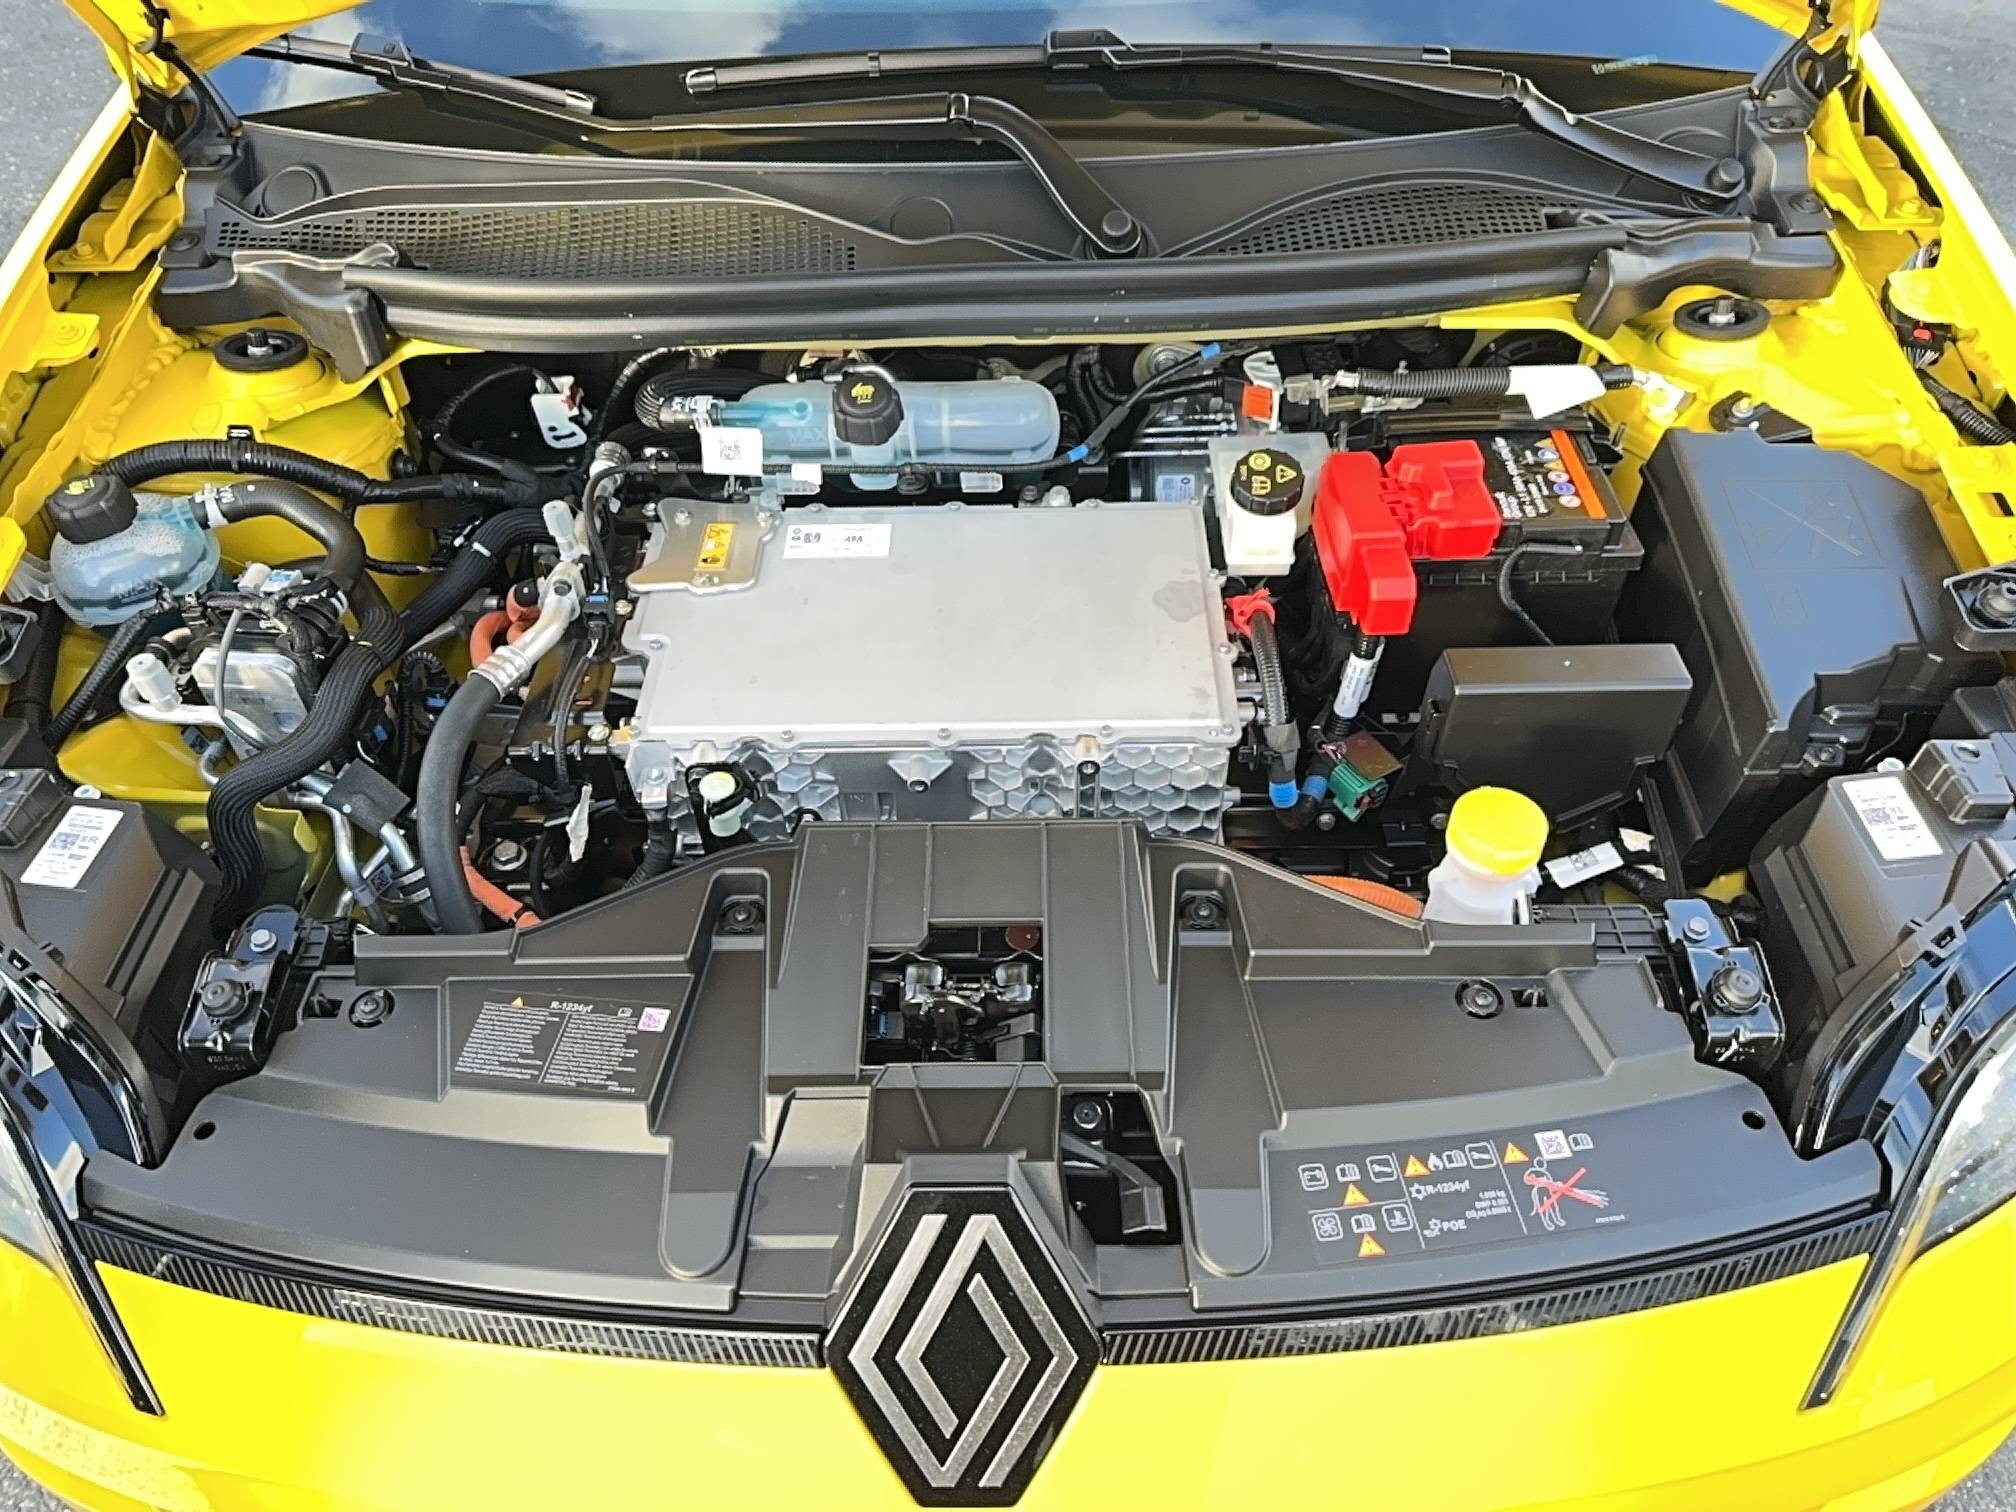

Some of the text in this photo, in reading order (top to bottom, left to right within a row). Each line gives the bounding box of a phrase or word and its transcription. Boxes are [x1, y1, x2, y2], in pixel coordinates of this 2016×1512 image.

[787, 427, 827, 441] MAX
[550, 1000, 594, 1014] R-1234yf
[1425, 1180, 1470, 1195] R-1234yf
[1442, 1219, 1467, 1231] POE
